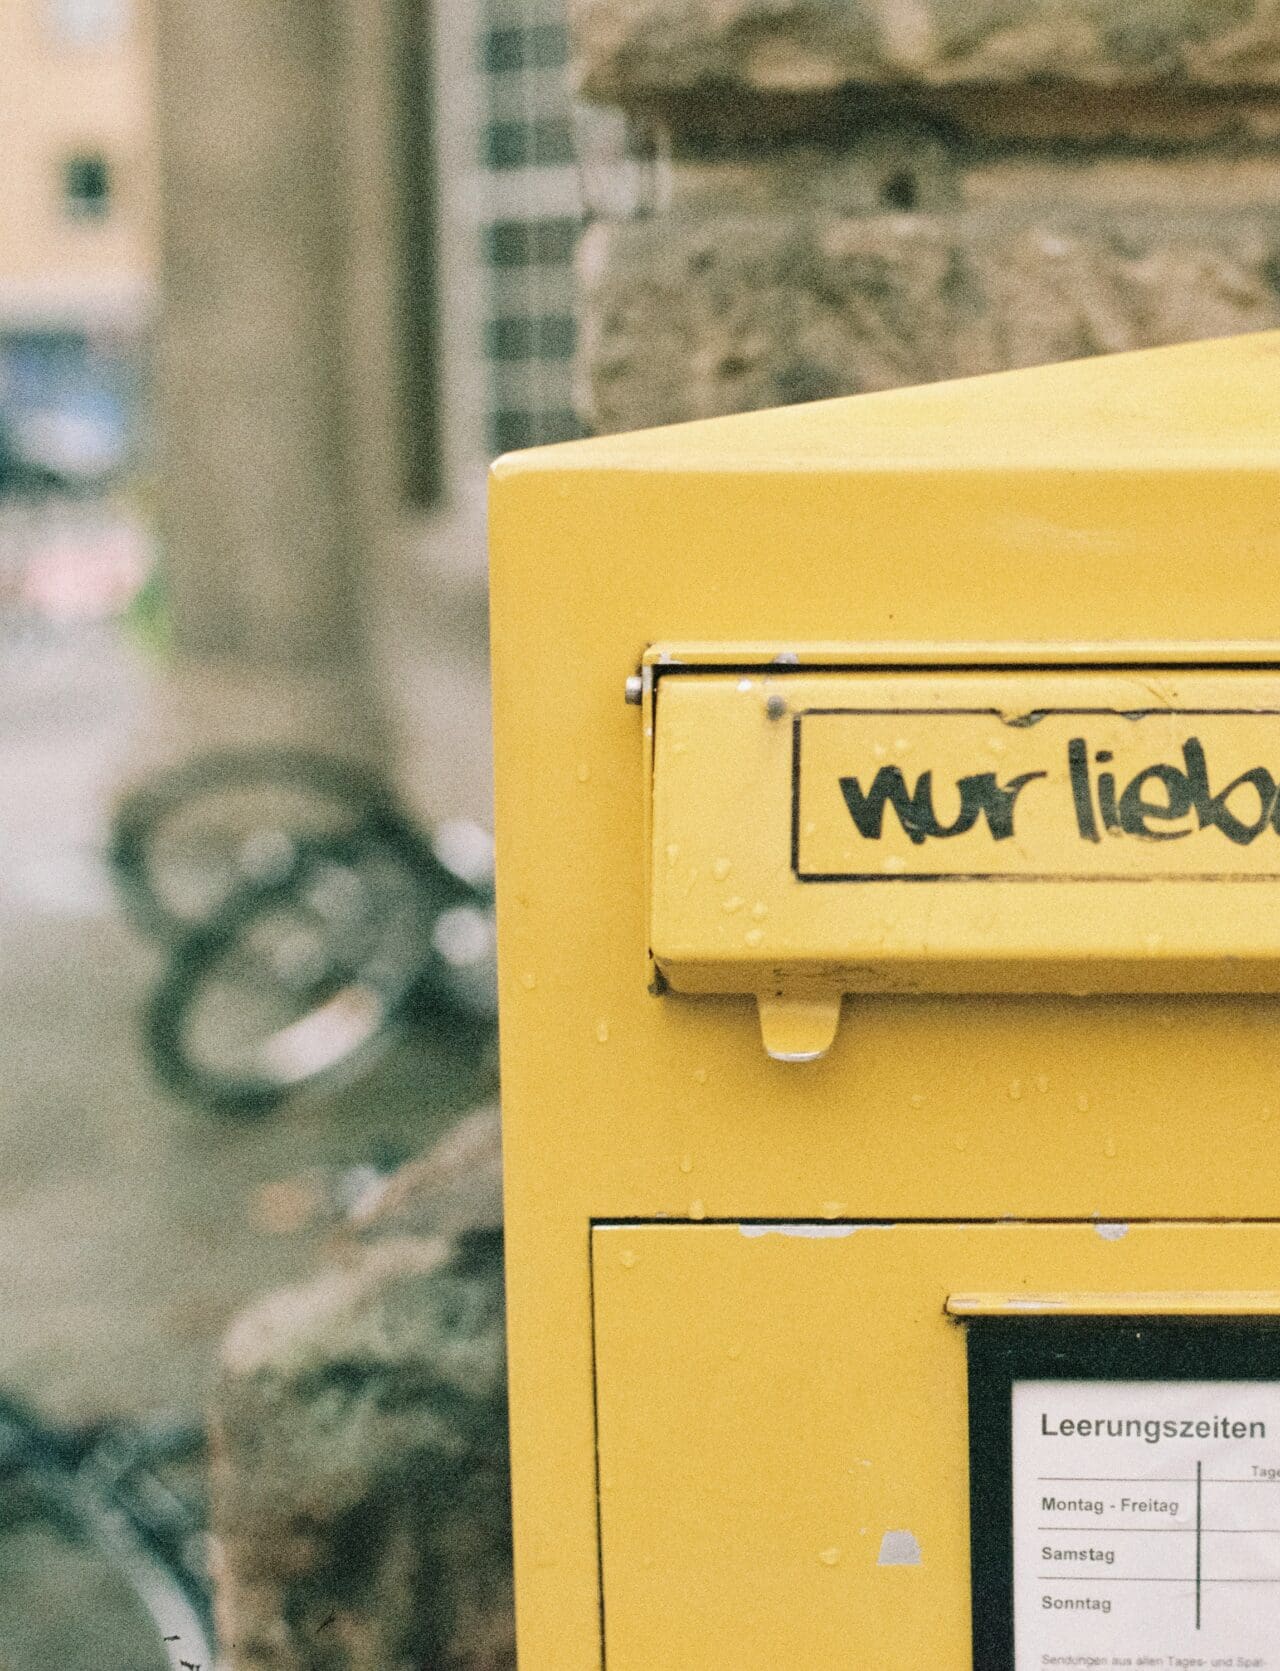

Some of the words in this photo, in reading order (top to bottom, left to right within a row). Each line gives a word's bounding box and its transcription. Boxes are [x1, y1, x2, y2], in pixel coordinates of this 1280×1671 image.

[1041, 1413, 1267, 1444] Leerungszeiten
[1042, 1497, 1104, 1514] Montag
[1121, 1498, 1179, 1515] Freitag
[1042, 1547, 1115, 1564] Samstag
[1042, 1596, 1112, 1613] Sonntag
[1041, 1654, 1107, 1667] Sendungen
[1111, 1656, 1132, 1666] aus
[1210, 1657, 1233, 1668] und
